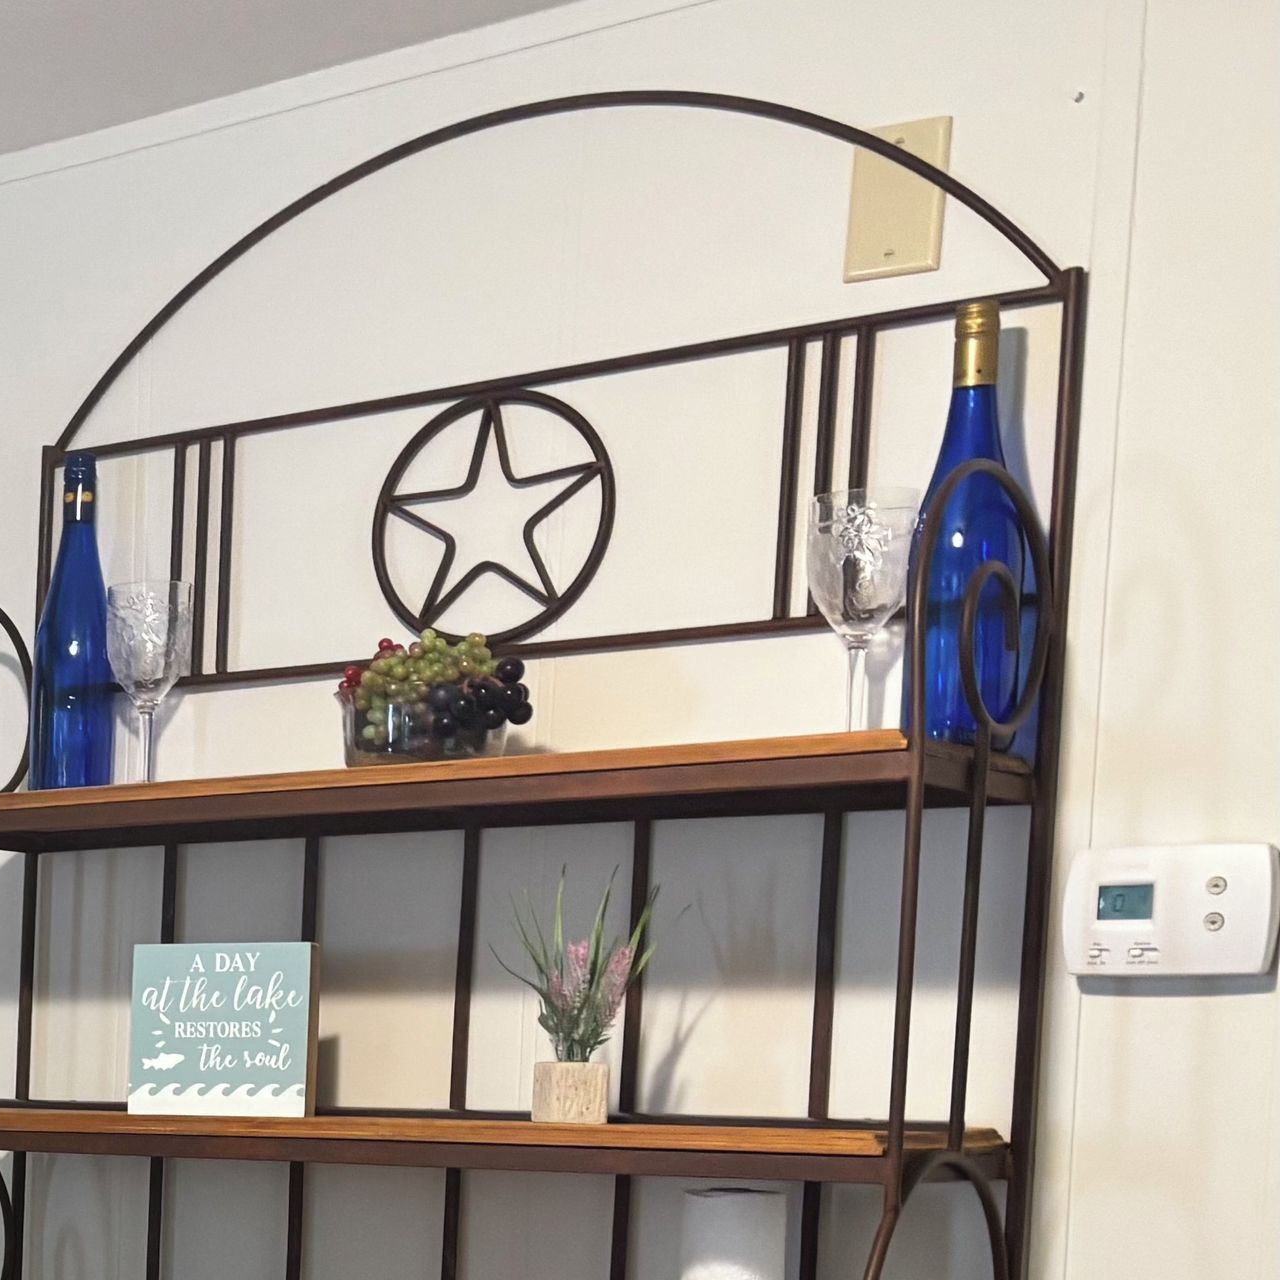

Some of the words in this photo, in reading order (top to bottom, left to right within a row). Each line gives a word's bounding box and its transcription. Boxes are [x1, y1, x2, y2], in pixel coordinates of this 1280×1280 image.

[190, 953, 205, 972] A
[215, 952, 260, 972] DAY
[141, 976, 173, 1013] at
[178, 976, 226, 1013] the
[233, 971, 303, 1011] lake
[174, 1021, 262, 1038] RESTORES
[197, 1043, 238, 1071] the
[243, 1043, 292, 1071] soul
